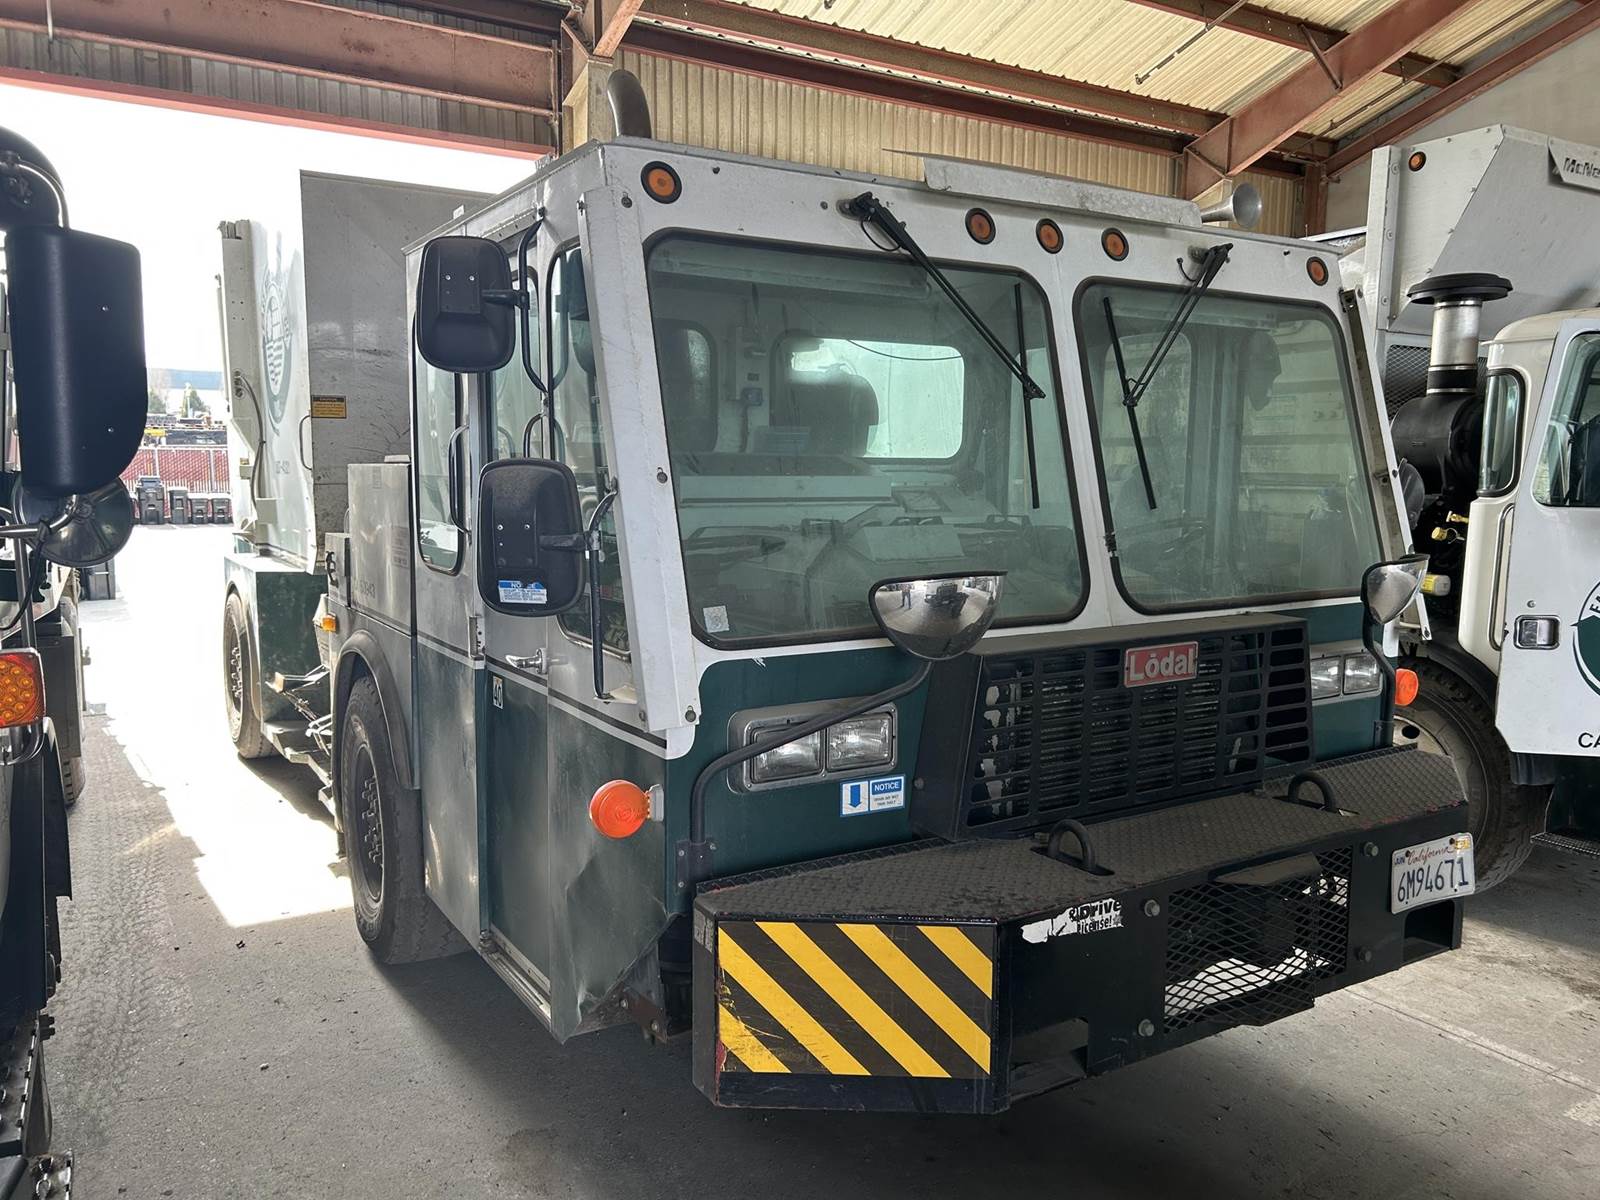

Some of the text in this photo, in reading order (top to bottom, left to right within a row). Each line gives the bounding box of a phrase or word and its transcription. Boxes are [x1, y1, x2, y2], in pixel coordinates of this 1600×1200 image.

[874, 781, 900, 792] NOTICE
[1408, 846, 1454, 867] California
[1397, 856, 1469, 902] 6M94671
[1080, 900, 1122, 920] Drive
